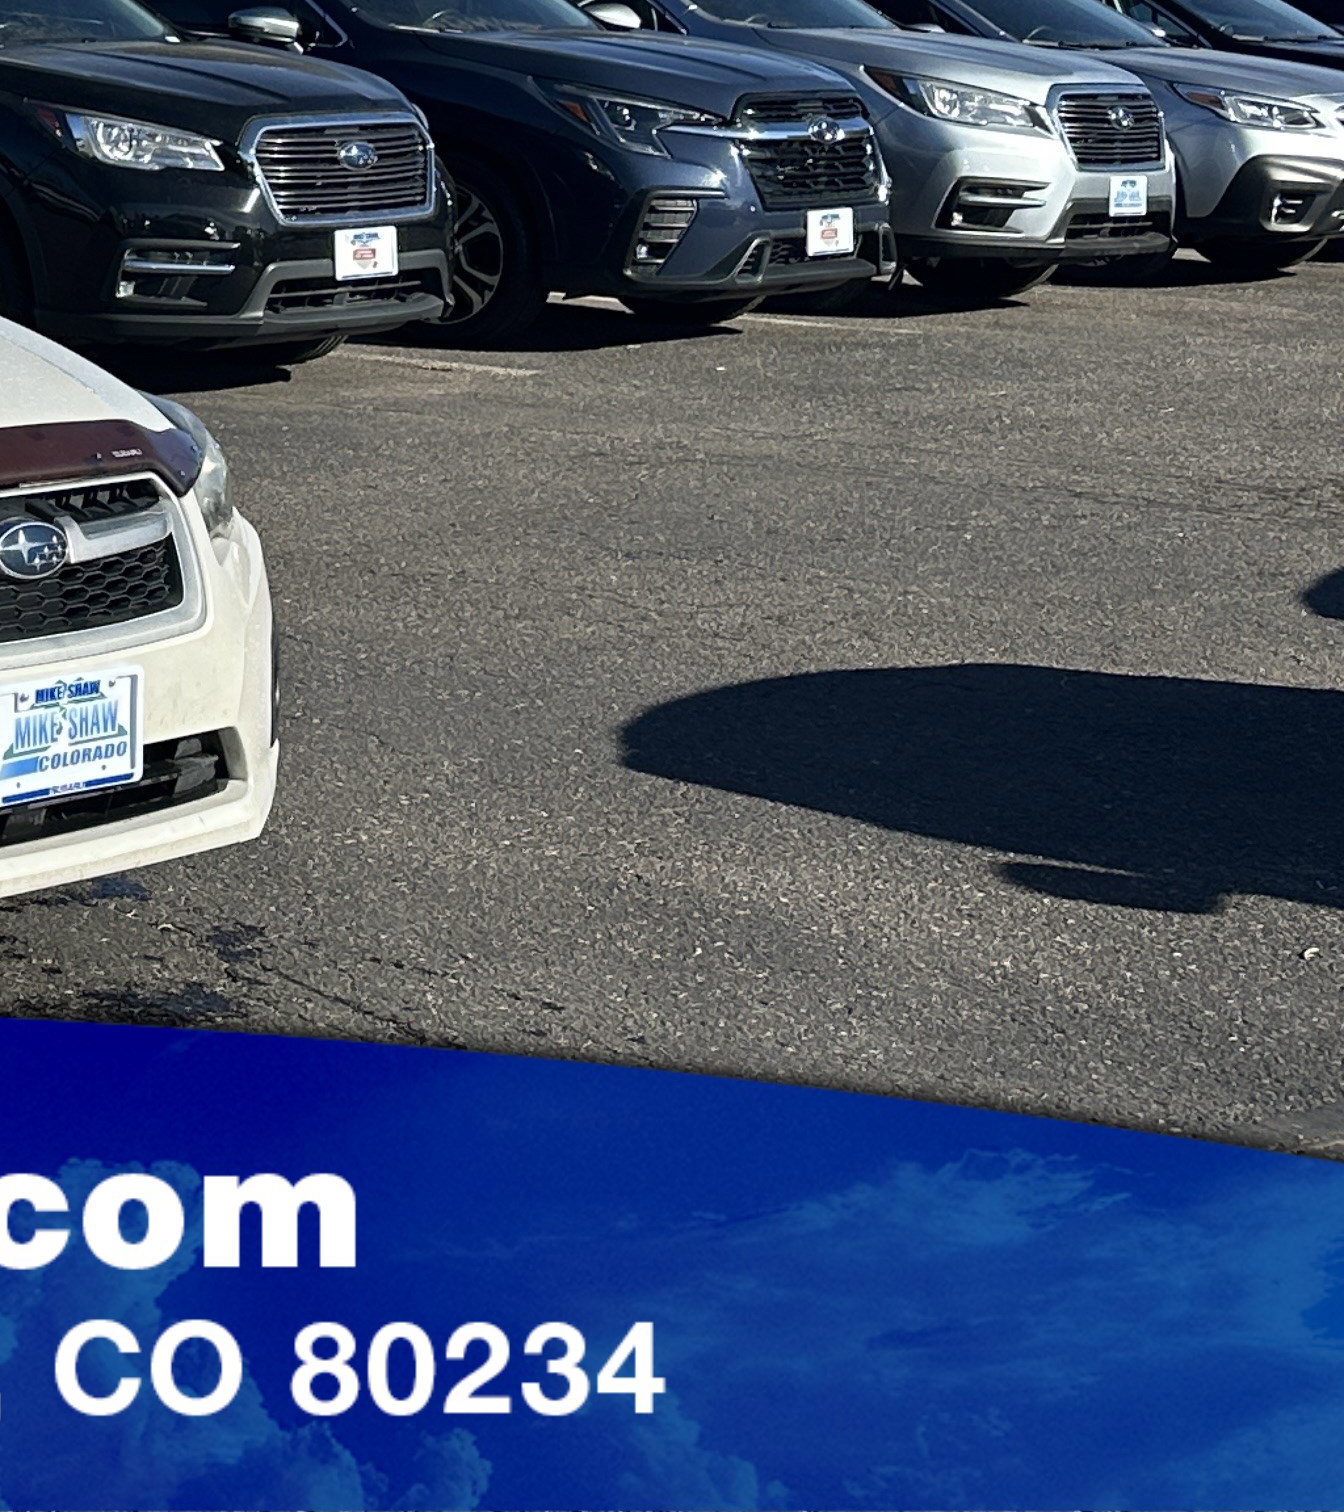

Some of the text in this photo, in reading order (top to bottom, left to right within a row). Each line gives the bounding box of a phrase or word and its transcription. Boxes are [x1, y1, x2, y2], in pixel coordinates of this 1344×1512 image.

[35, 680, 101, 704] MIKE SHAW
[14, 699, 119, 751] MIKE SHAW
[38, 741, 128, 773] COLORADO
